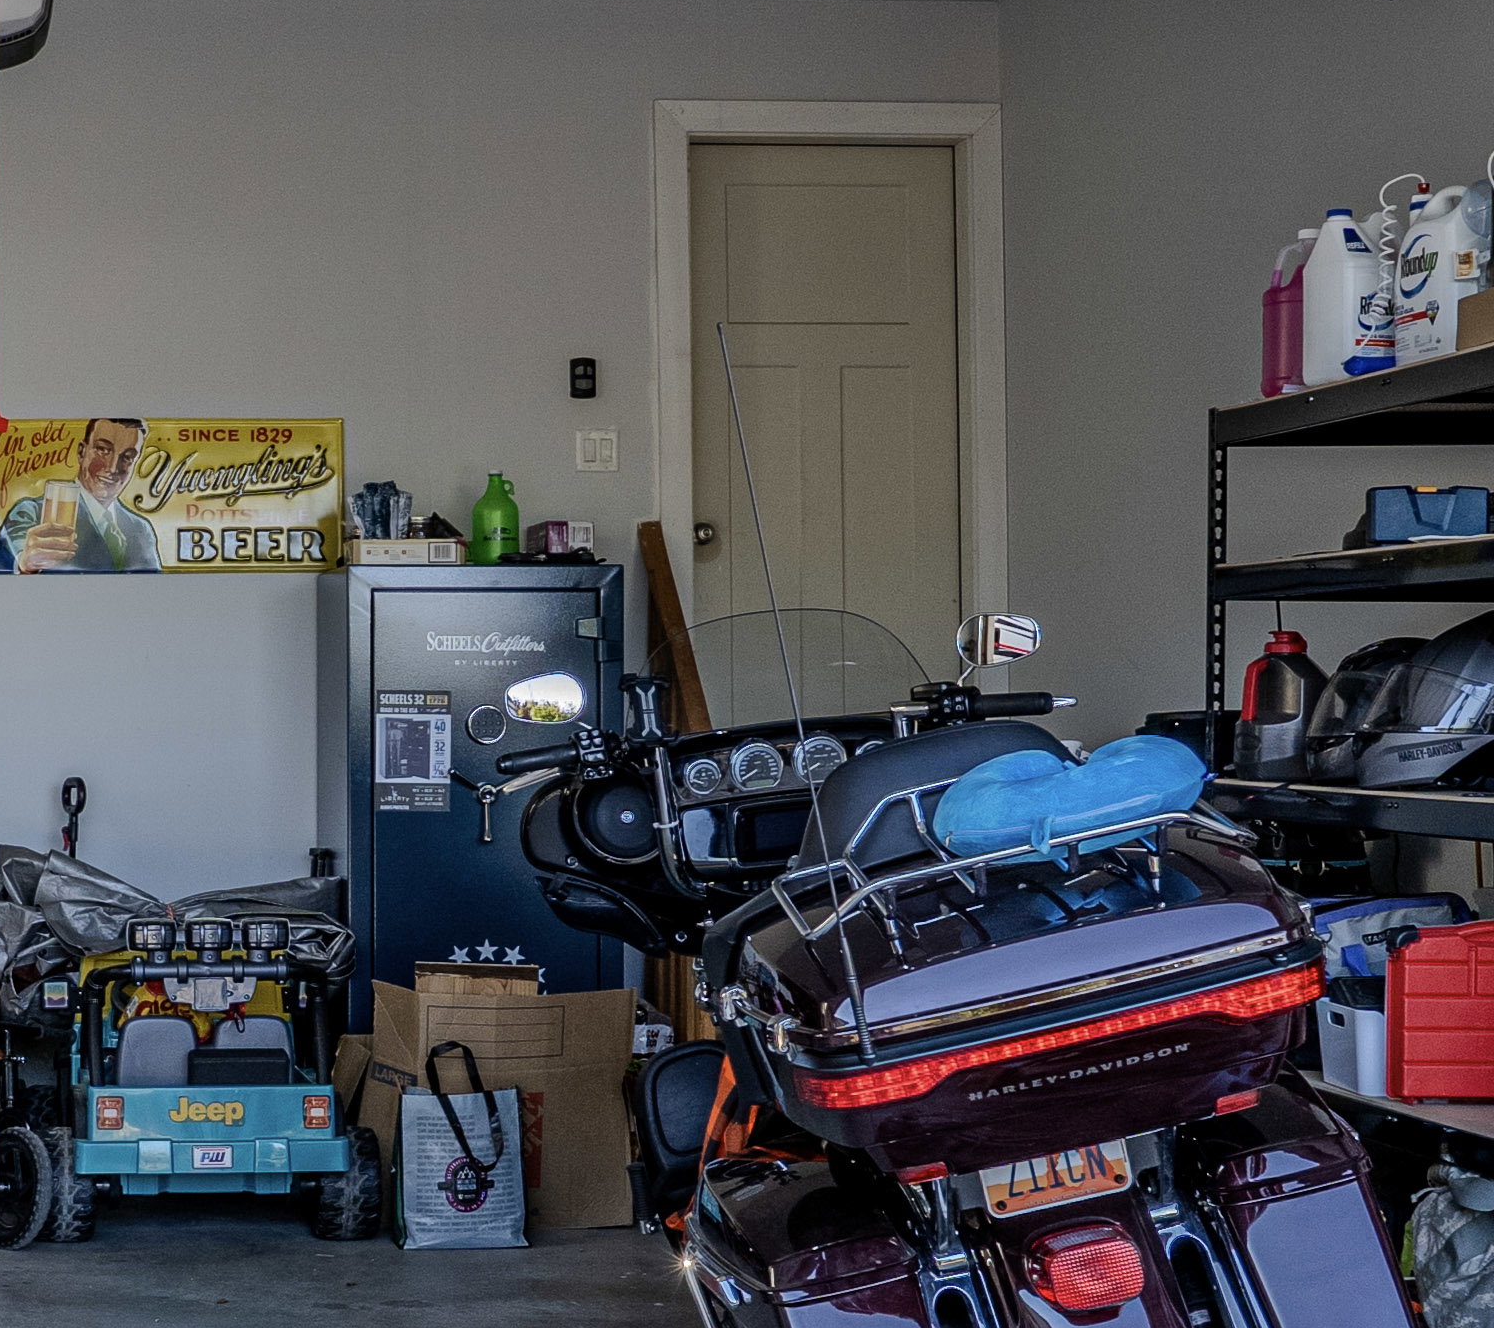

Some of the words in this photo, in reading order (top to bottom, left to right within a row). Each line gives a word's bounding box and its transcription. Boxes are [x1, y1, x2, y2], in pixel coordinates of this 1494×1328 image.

[31, 421, 69, 446] old
[178, 428, 240, 443] SINCE
[250, 428, 294, 445] 1829
[0, 437, 73, 508] friend
[135, 444, 336, 513] Yuengling's
[177, 527, 328, 563] BEER
[426, 631, 481, 652] SCHEELS
[481, 631, 546, 656] Outfitters
[380, 694, 413, 705] SCHEELS
[414, 694, 425, 705] 32
[435, 720, 446, 732] 40
[435, 741, 446, 752] 32
[1397, 739, 1465, 763] HARLEY-DAVIDSON
[375, 1064, 413, 1086] LARGE
[967, 1042, 1191, 1102] HARLEY-DAVIDSON
[169, 1096, 245, 1126] Jeep
